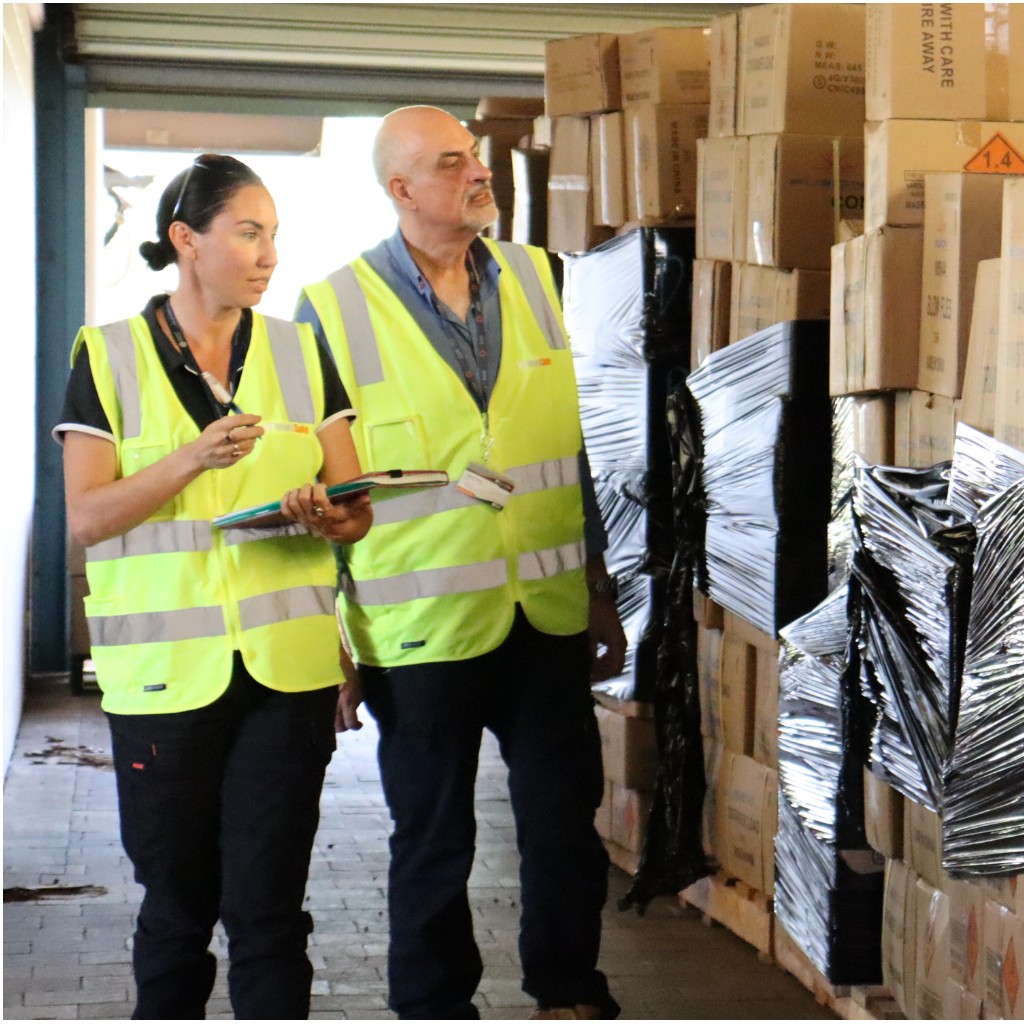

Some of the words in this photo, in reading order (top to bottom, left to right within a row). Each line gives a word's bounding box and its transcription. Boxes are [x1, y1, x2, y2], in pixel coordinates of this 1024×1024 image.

[939, 3, 953, 44] WITH
[921, 31, 935, 73] AWAY
[940, 47, 954, 88] CARE
[982, 150, 1012, 168] 1.4
